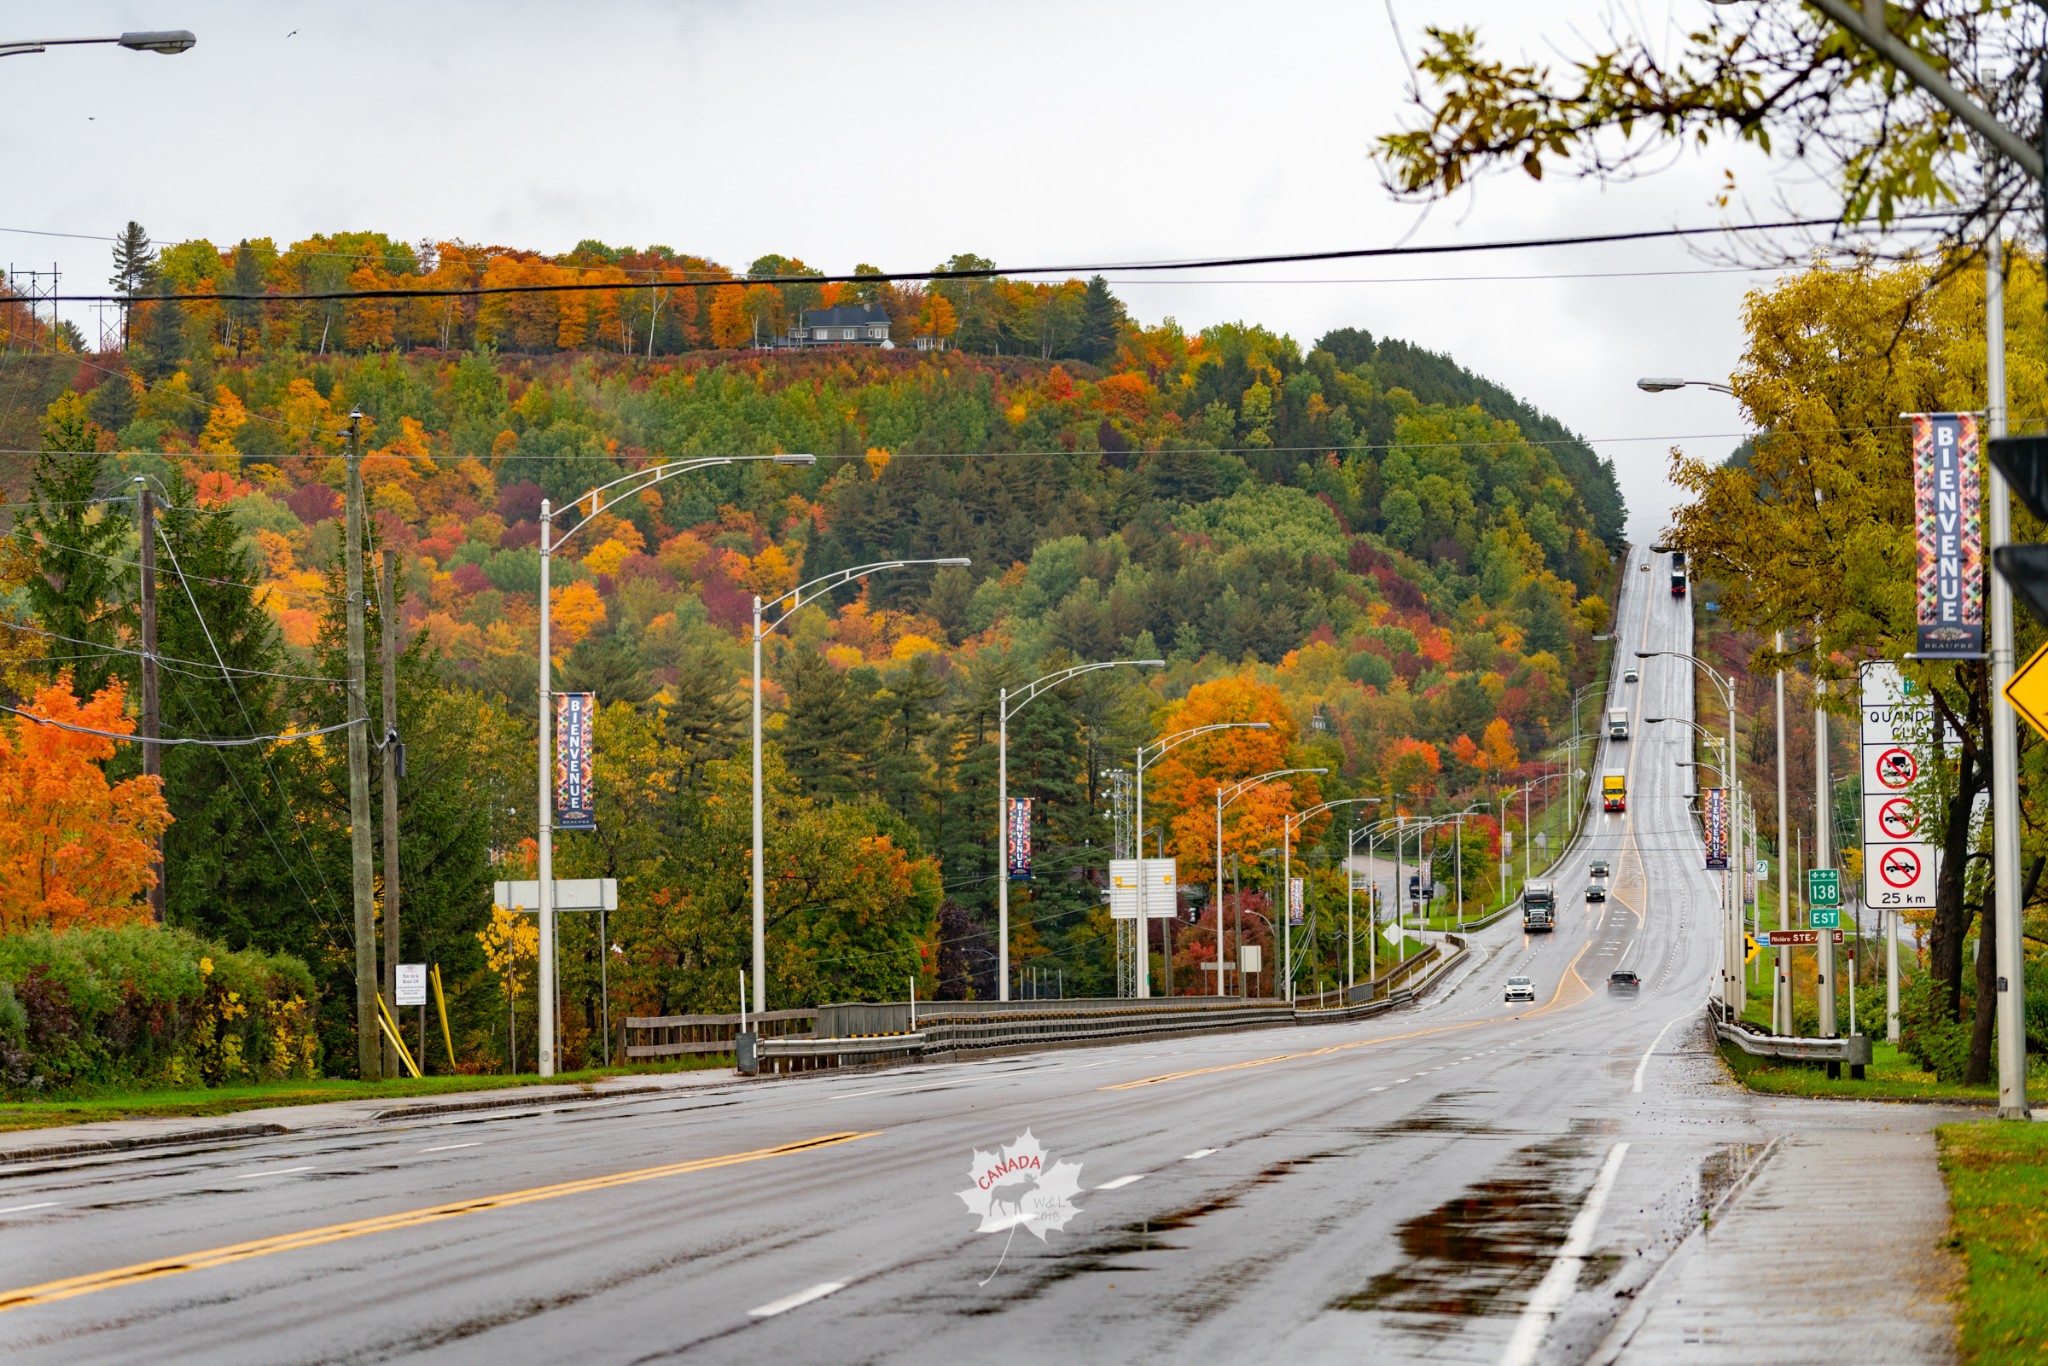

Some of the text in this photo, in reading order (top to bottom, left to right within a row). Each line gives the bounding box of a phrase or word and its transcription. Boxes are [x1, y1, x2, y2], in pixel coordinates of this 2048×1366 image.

[1937, 426, 1958, 622] BIENVENUE
[1870, 710, 1925, 723] QUAND
[569, 700, 580, 809] BIENVENUE
[1712, 792, 1720, 859] BIENVENUE
[1812, 885, 1836, 900] 138
[1881, 892, 1926, 904] 25 km
[1813, 912, 1836, 924] EST
